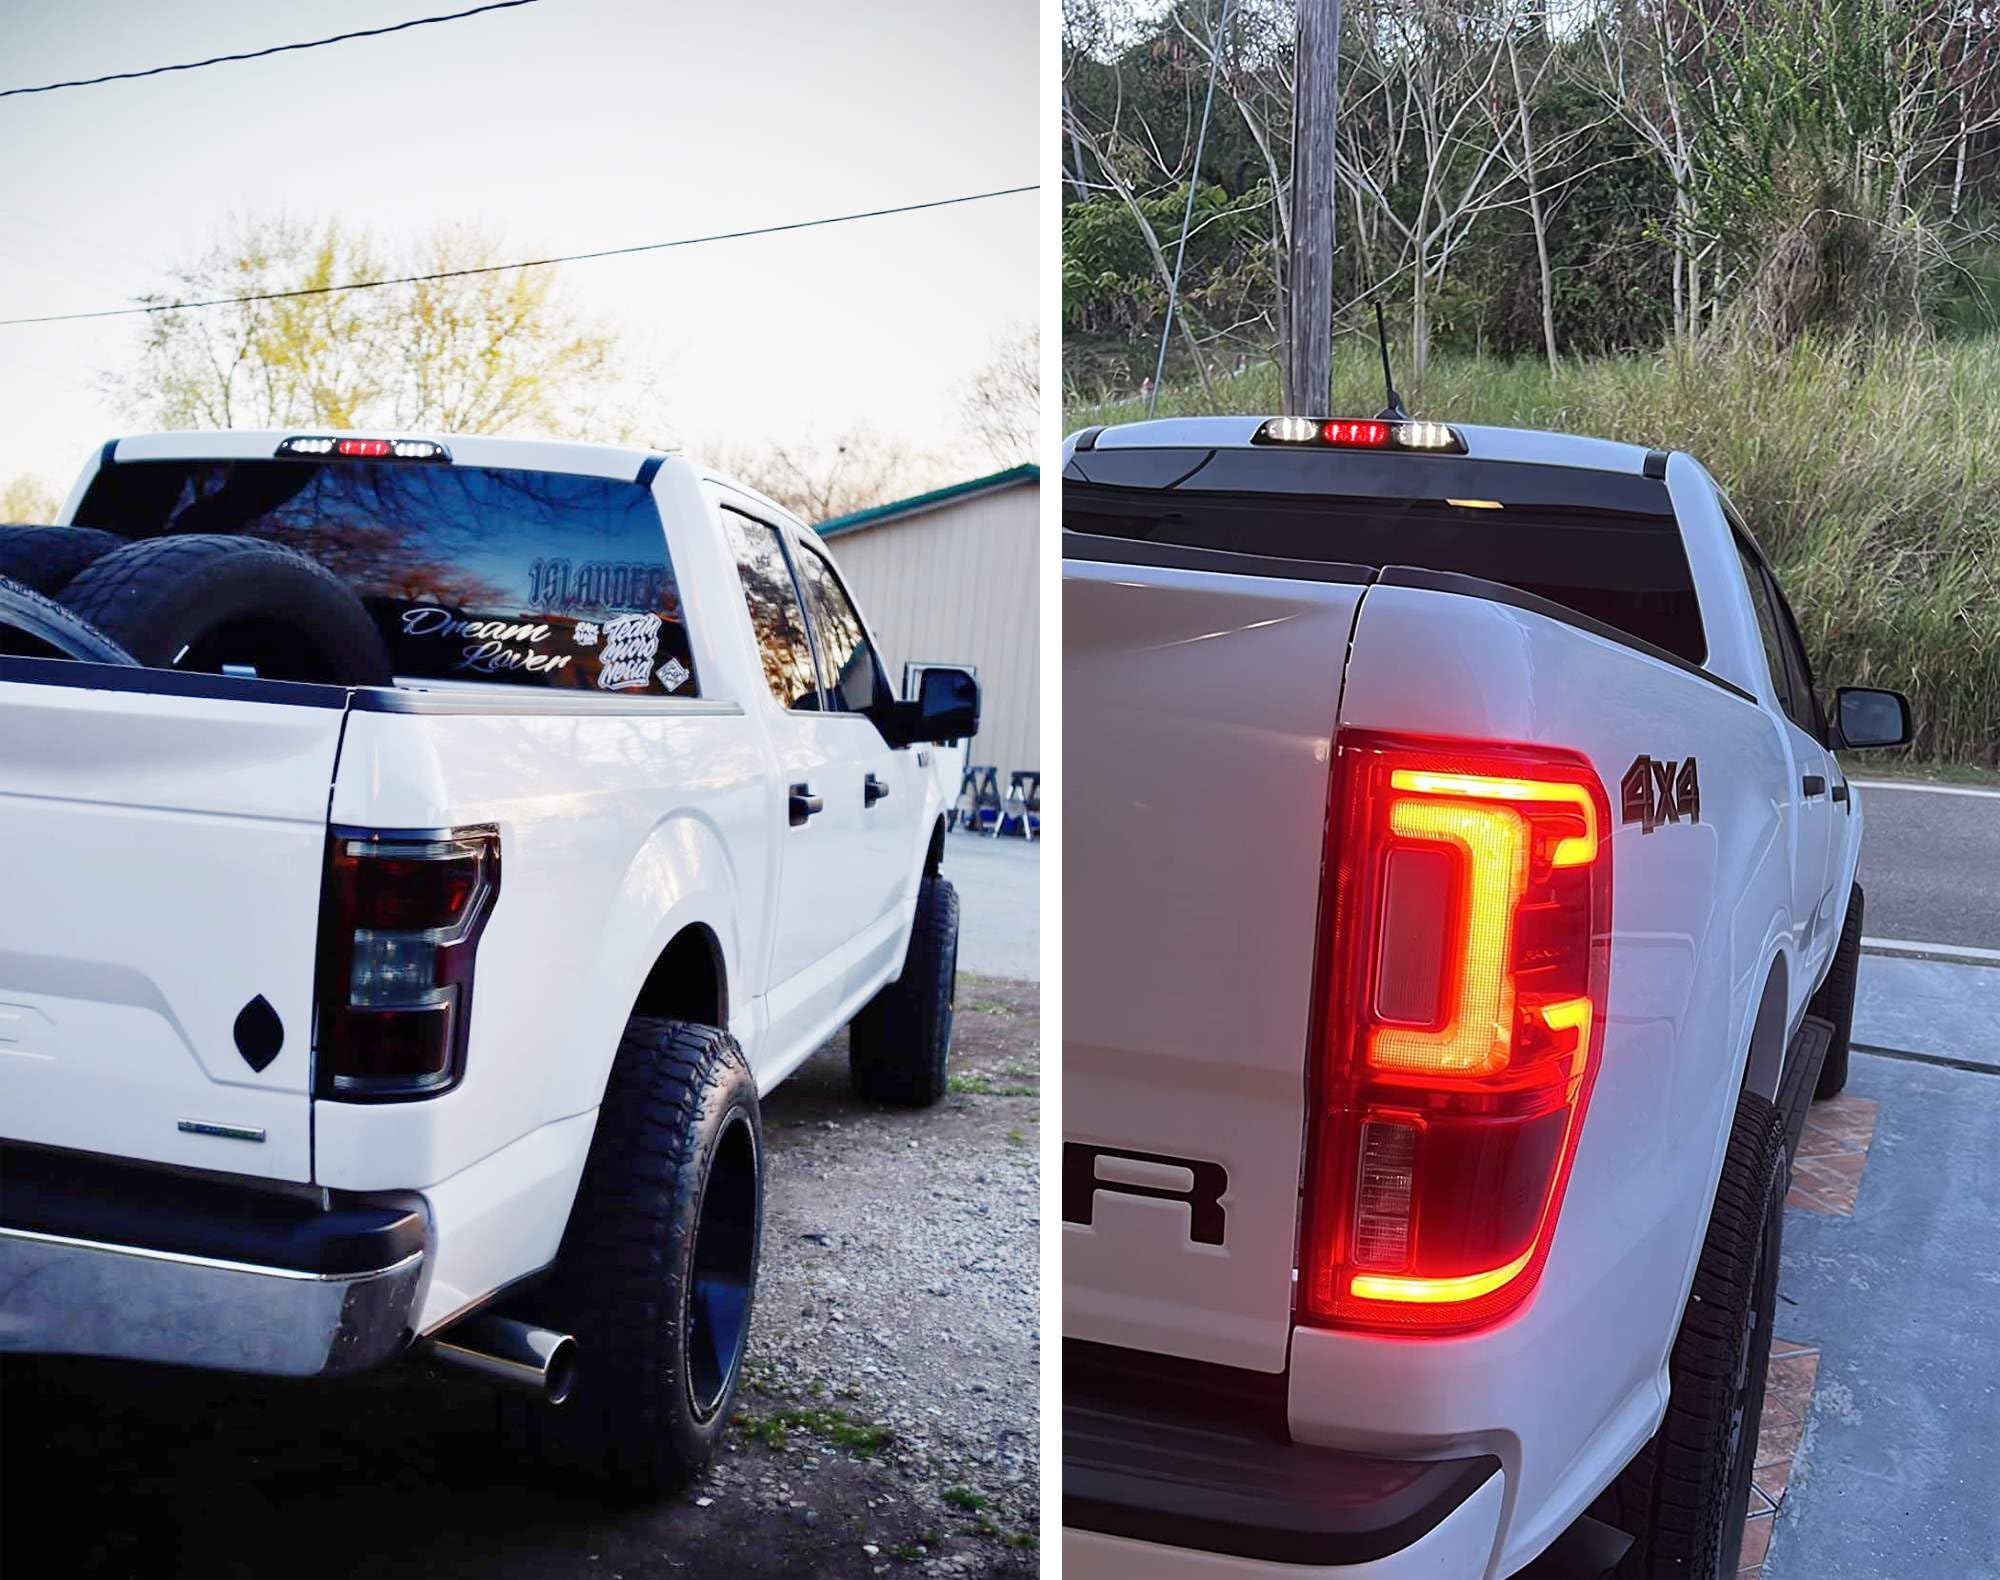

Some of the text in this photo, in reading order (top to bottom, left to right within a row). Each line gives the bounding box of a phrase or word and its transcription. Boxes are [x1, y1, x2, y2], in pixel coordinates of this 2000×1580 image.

[402, 608, 551, 642] Dream
[457, 641, 572, 672] Lover
[1062, 1141, 1228, 1246] R
